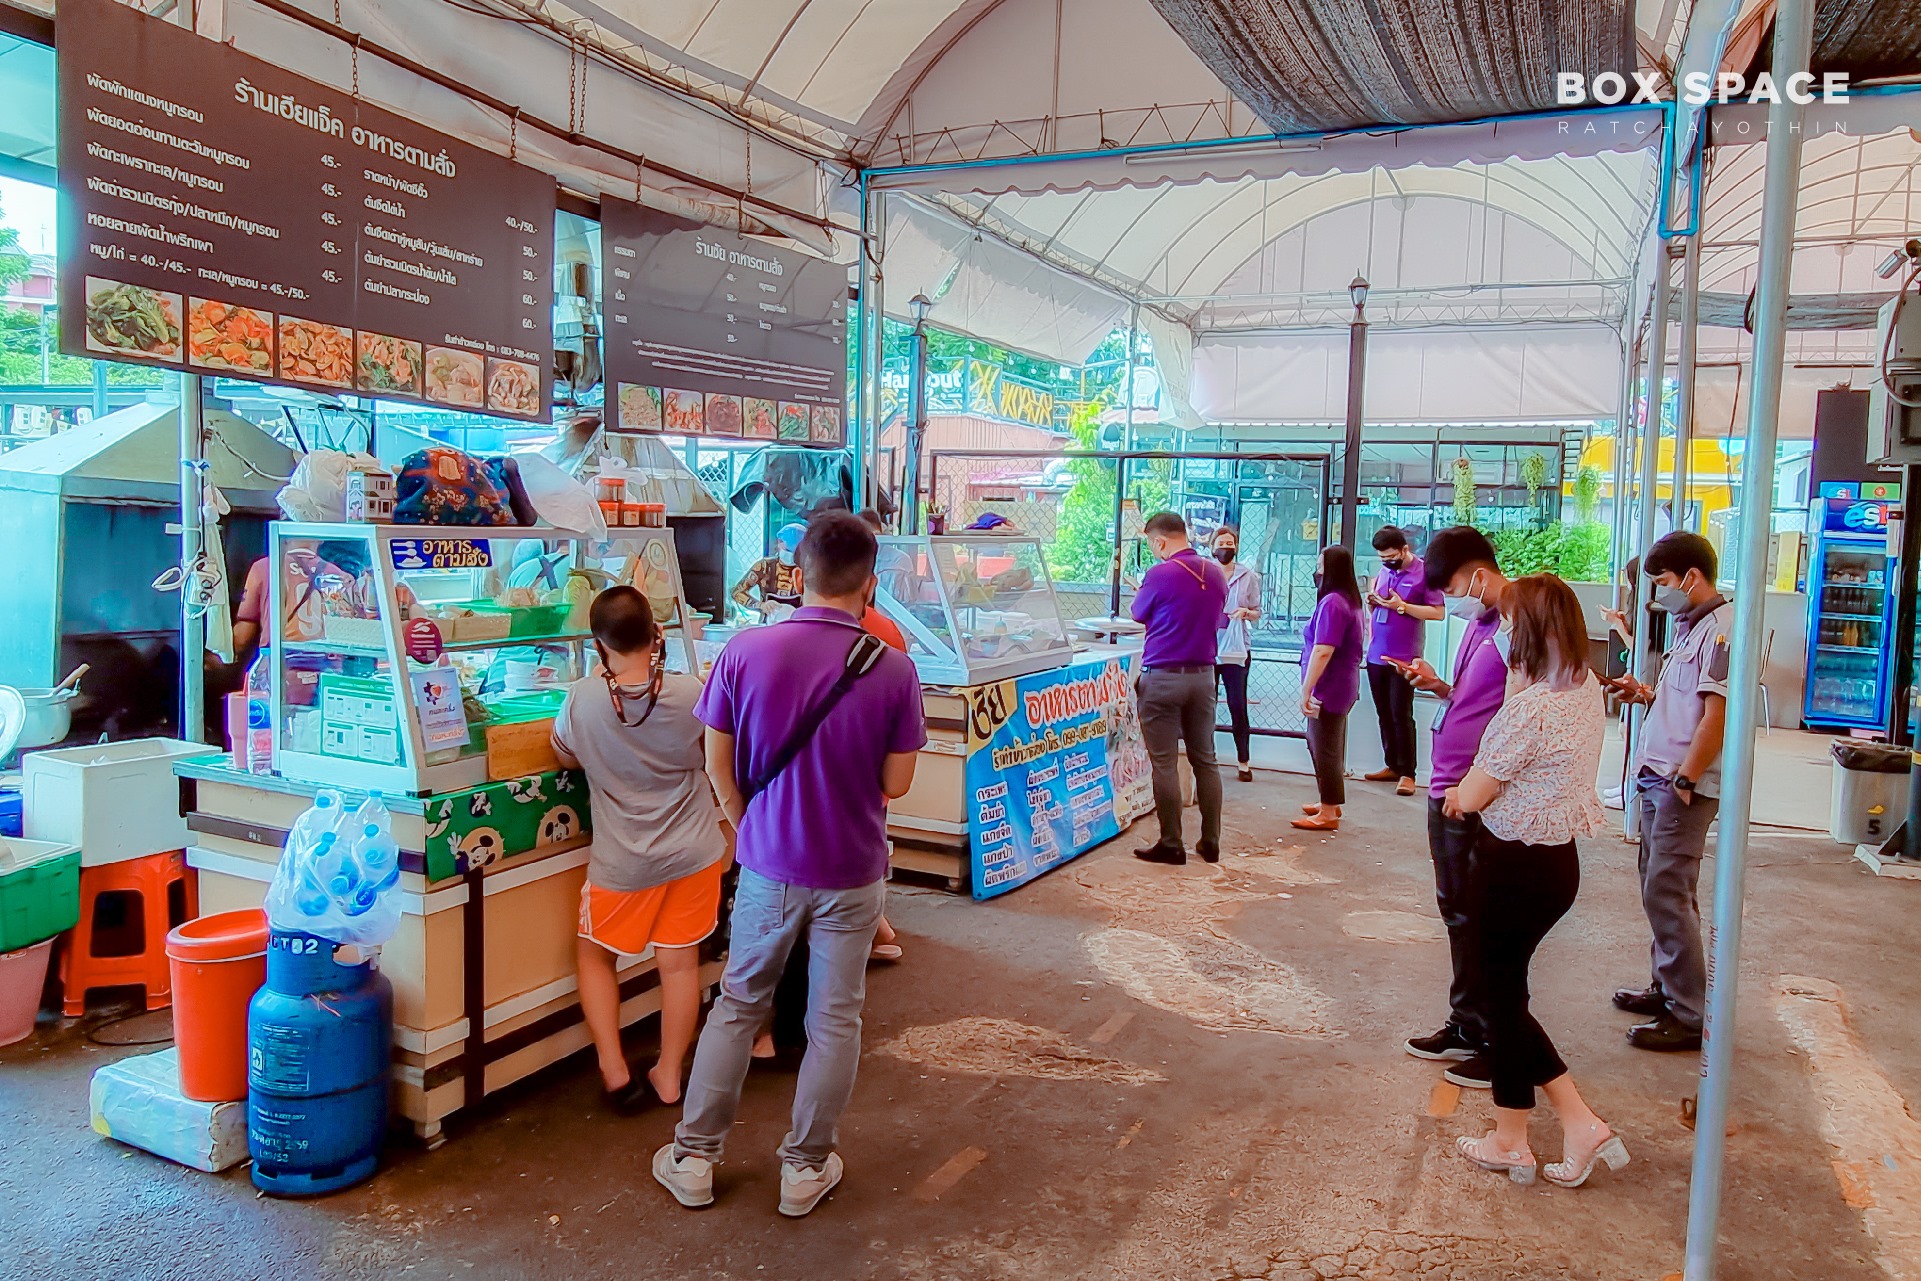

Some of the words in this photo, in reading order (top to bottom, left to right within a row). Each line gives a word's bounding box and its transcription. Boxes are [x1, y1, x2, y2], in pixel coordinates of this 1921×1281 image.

[351, 126, 456, 178] อาหารตามสั่ง
[880, 370, 963, 389] Haout
[422, 540, 472, 555] อาหาร
[1867, 819, 1881, 835] 5
